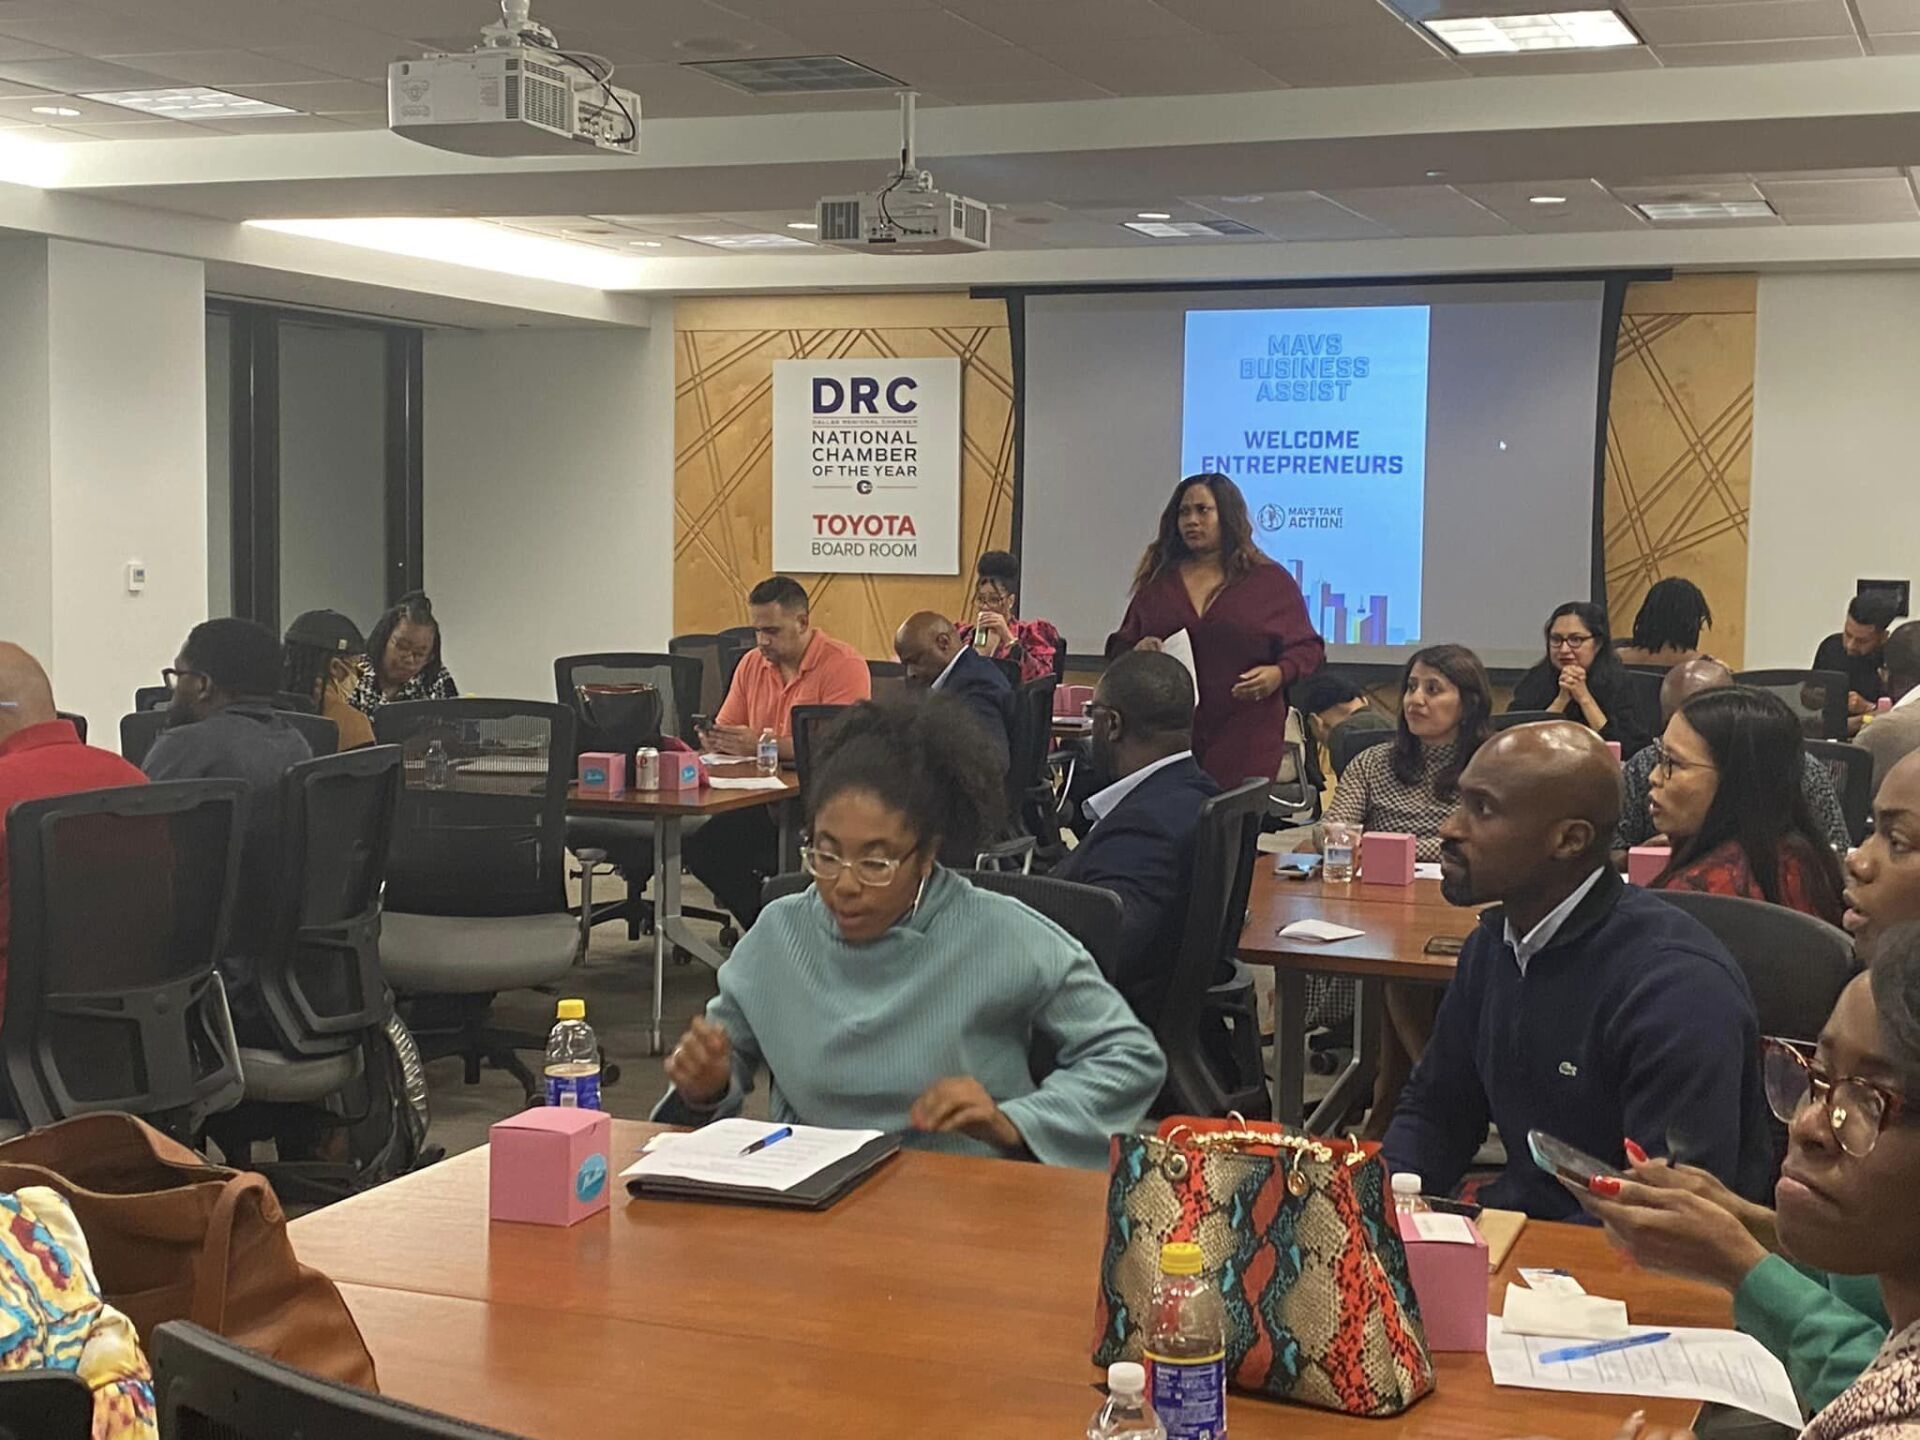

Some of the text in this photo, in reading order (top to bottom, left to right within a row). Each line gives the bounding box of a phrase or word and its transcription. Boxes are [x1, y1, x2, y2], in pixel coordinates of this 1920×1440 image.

[1268, 334, 1343, 356] MAVS
[1240, 356, 1370, 379] BUSINESS
[812, 377, 918, 414] DRC
[1256, 380, 1352, 402] ASSIST
[812, 430, 917, 445] NATIONAL
[1245, 430, 1360, 449] WELCOME
[812, 448, 917, 462] CHAMBER
[812, 465, 917, 477] OF THE YEAR
[1202, 455, 1403, 475] ENTREPRENEURS
[1288, 507, 1343, 516] MAVS TAKE
[812, 514, 917, 536] TOYOTA
[1288, 517, 1343, 529] ACTION!
[811, 542, 917, 557] BOARD ROOM
